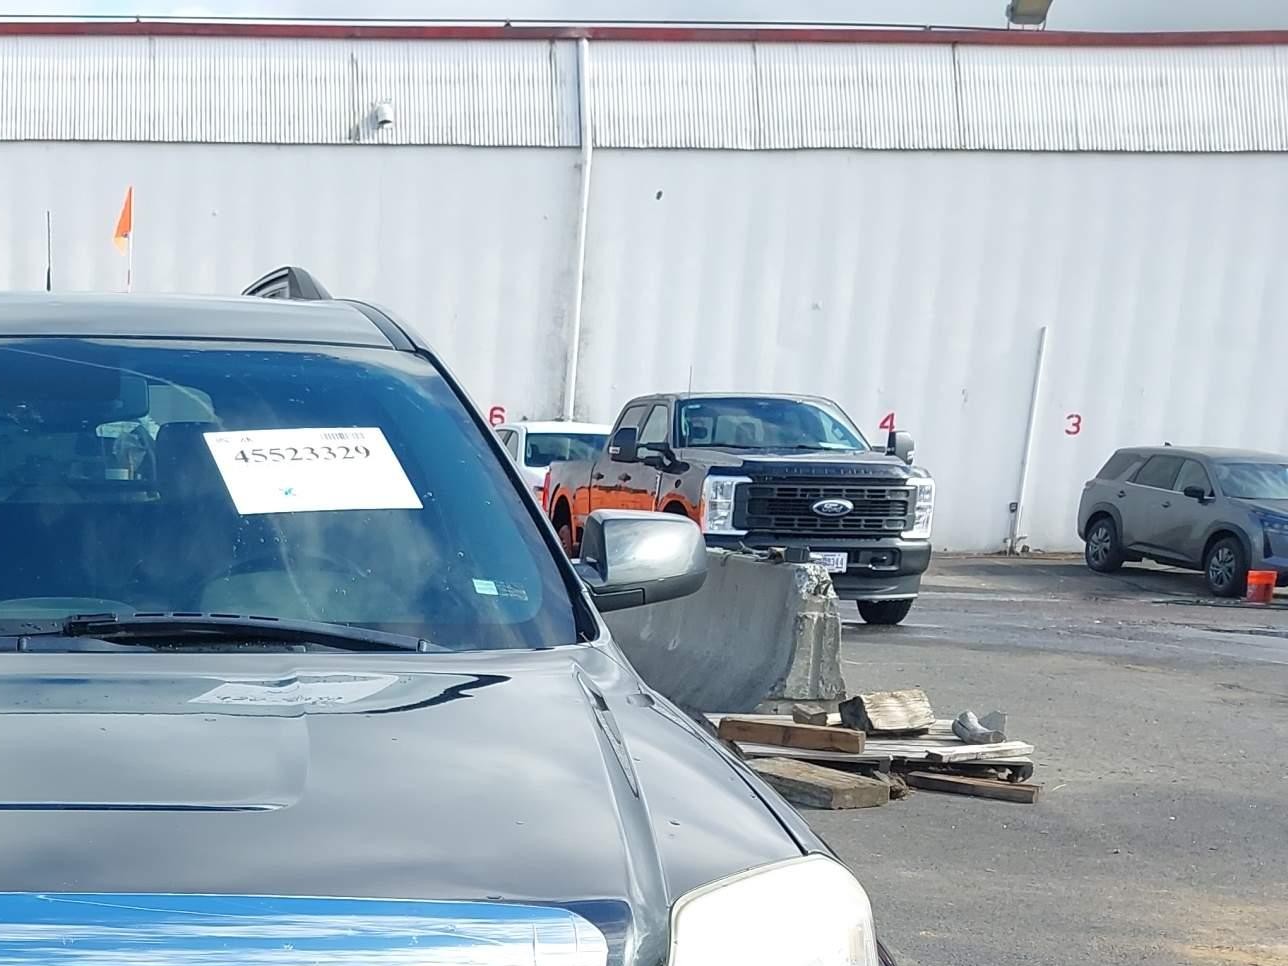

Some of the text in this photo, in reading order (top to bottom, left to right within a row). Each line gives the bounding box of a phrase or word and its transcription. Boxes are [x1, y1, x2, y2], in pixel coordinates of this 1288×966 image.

[489, 406, 505, 428] 6
[879, 412, 895, 432] 4
[1065, 414, 1082, 435] 3
[234, 445, 371, 463] 45523329
